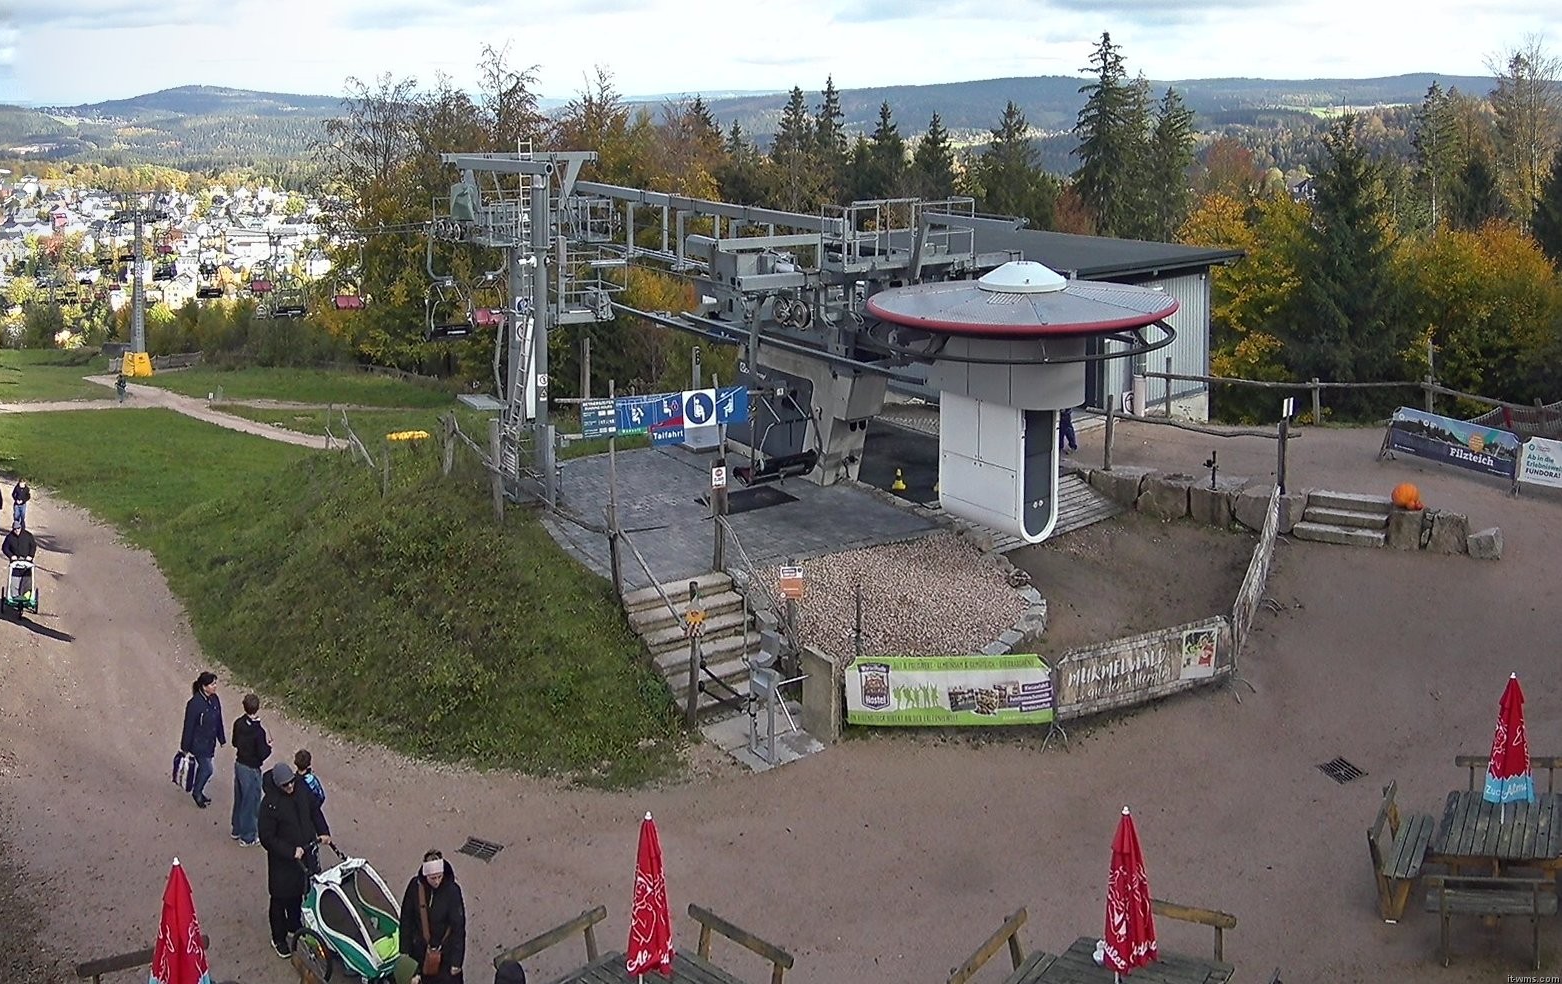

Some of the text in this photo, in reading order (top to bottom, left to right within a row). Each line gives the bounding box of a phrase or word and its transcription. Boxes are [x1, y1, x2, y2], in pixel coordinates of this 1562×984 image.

[652, 430, 684, 440] Talfahrt
[1450, 447, 1494, 466] Filzteich
[1527, 453, 1537, 461] Ab
[1068, 648, 1168, 687] MURMELWALD
